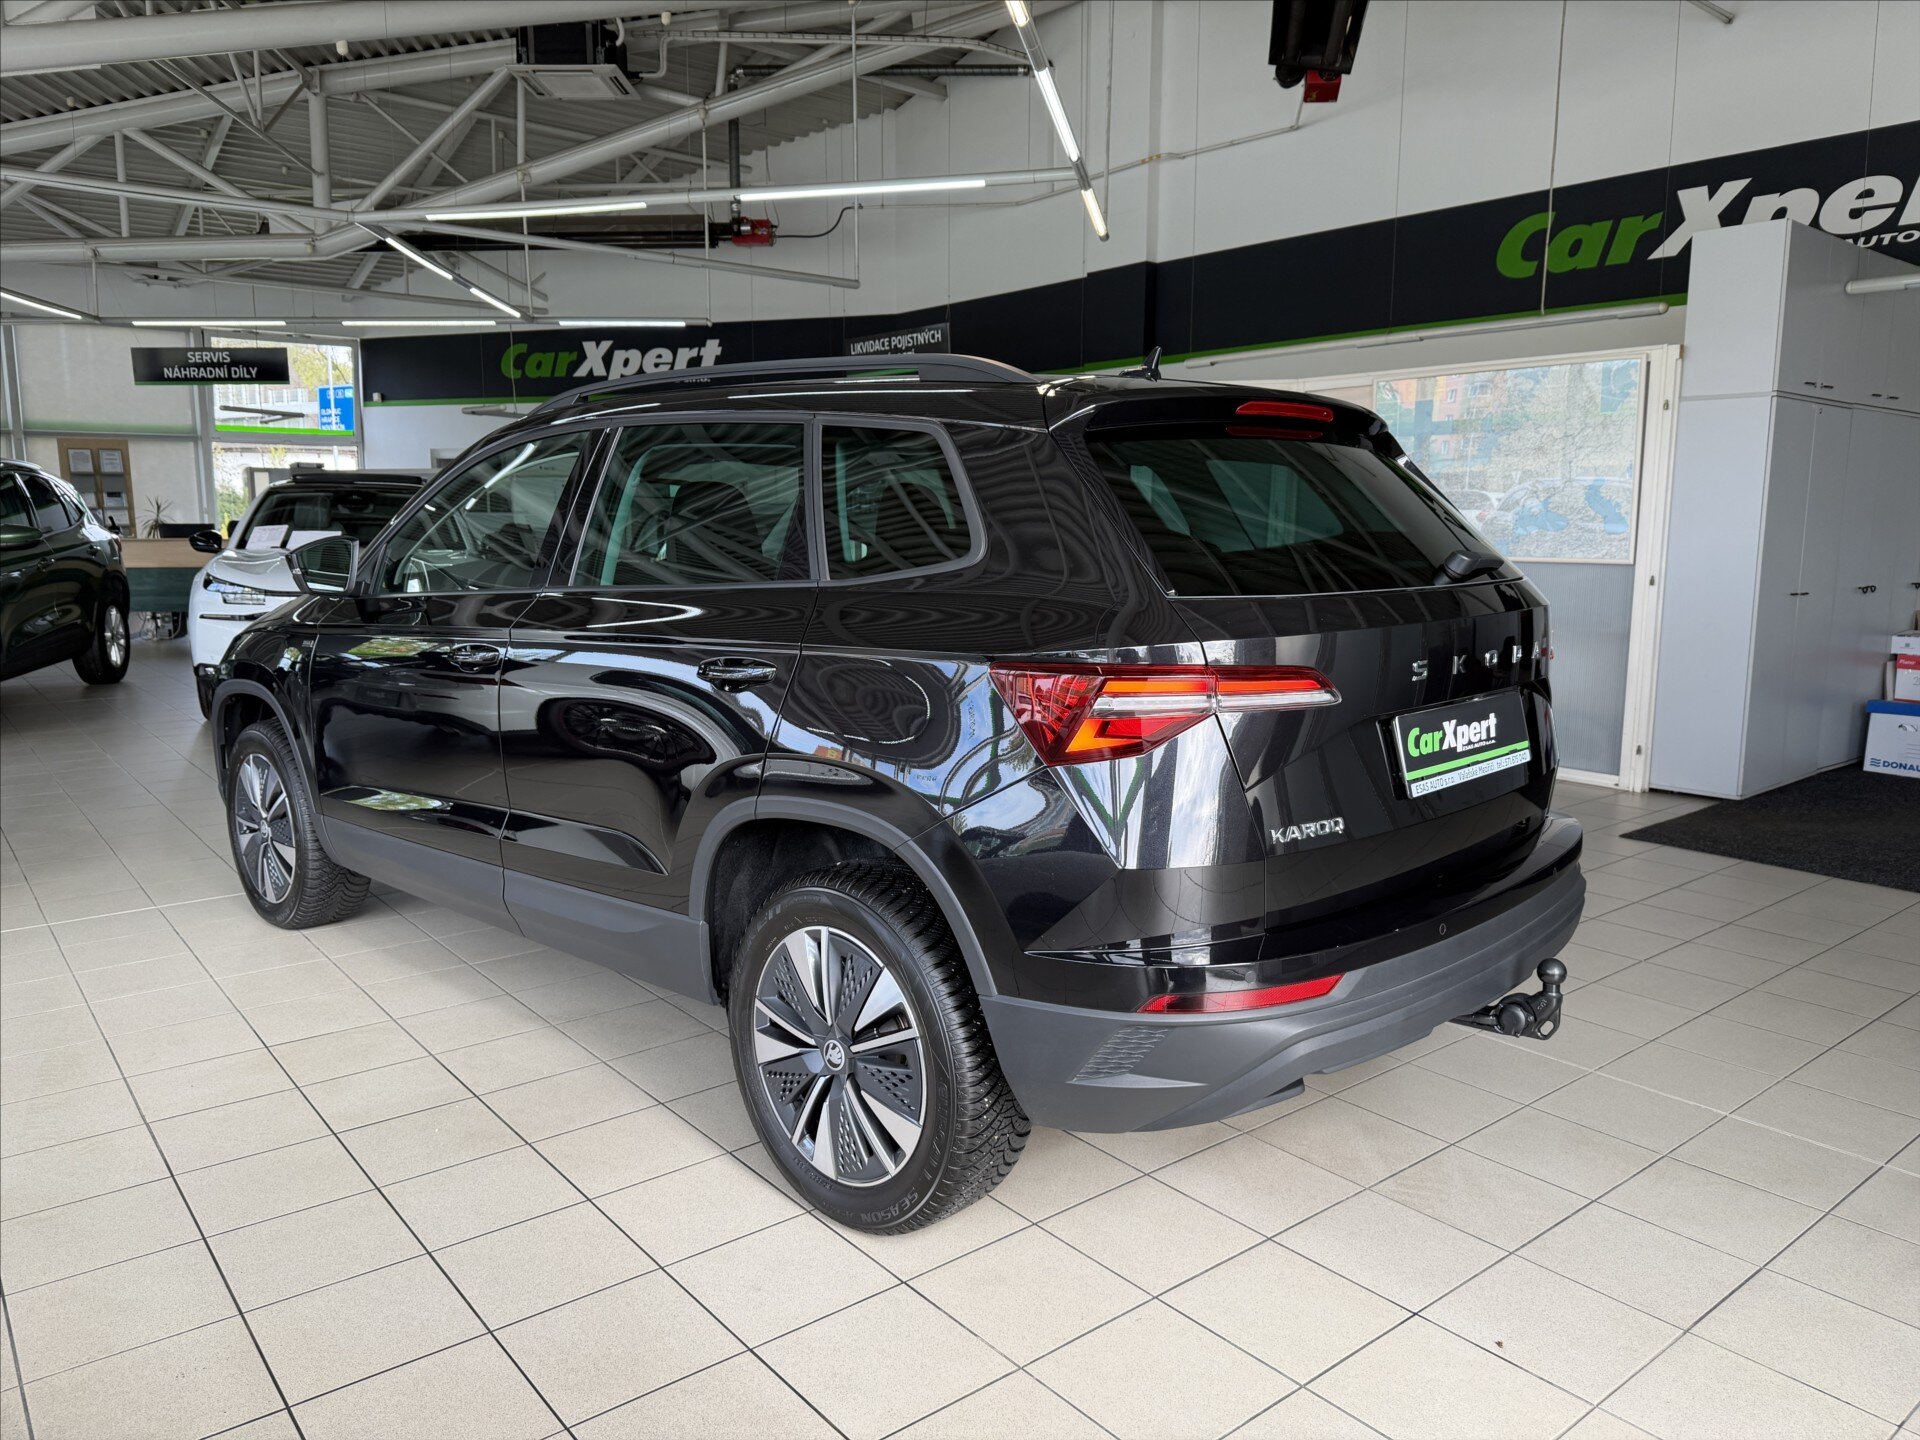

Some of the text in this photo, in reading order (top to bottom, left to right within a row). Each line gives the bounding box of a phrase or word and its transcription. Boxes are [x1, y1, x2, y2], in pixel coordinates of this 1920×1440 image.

[850, 338, 890, 355] LIKVIDACE
[891, 328, 942, 350] POJISTNÝCH
[187, 351, 231, 364] SERVIS
[501, 338, 722, 381] CarXpert
[163, 365, 258, 379] NÁHRADNÍ DÍLY
[1407, 712, 1498, 758] CarXpert
[1415, 781, 1430, 794] ESAS
[1430, 777, 1444, 789] AUTO
[1268, 816, 1345, 845] KAROQ
